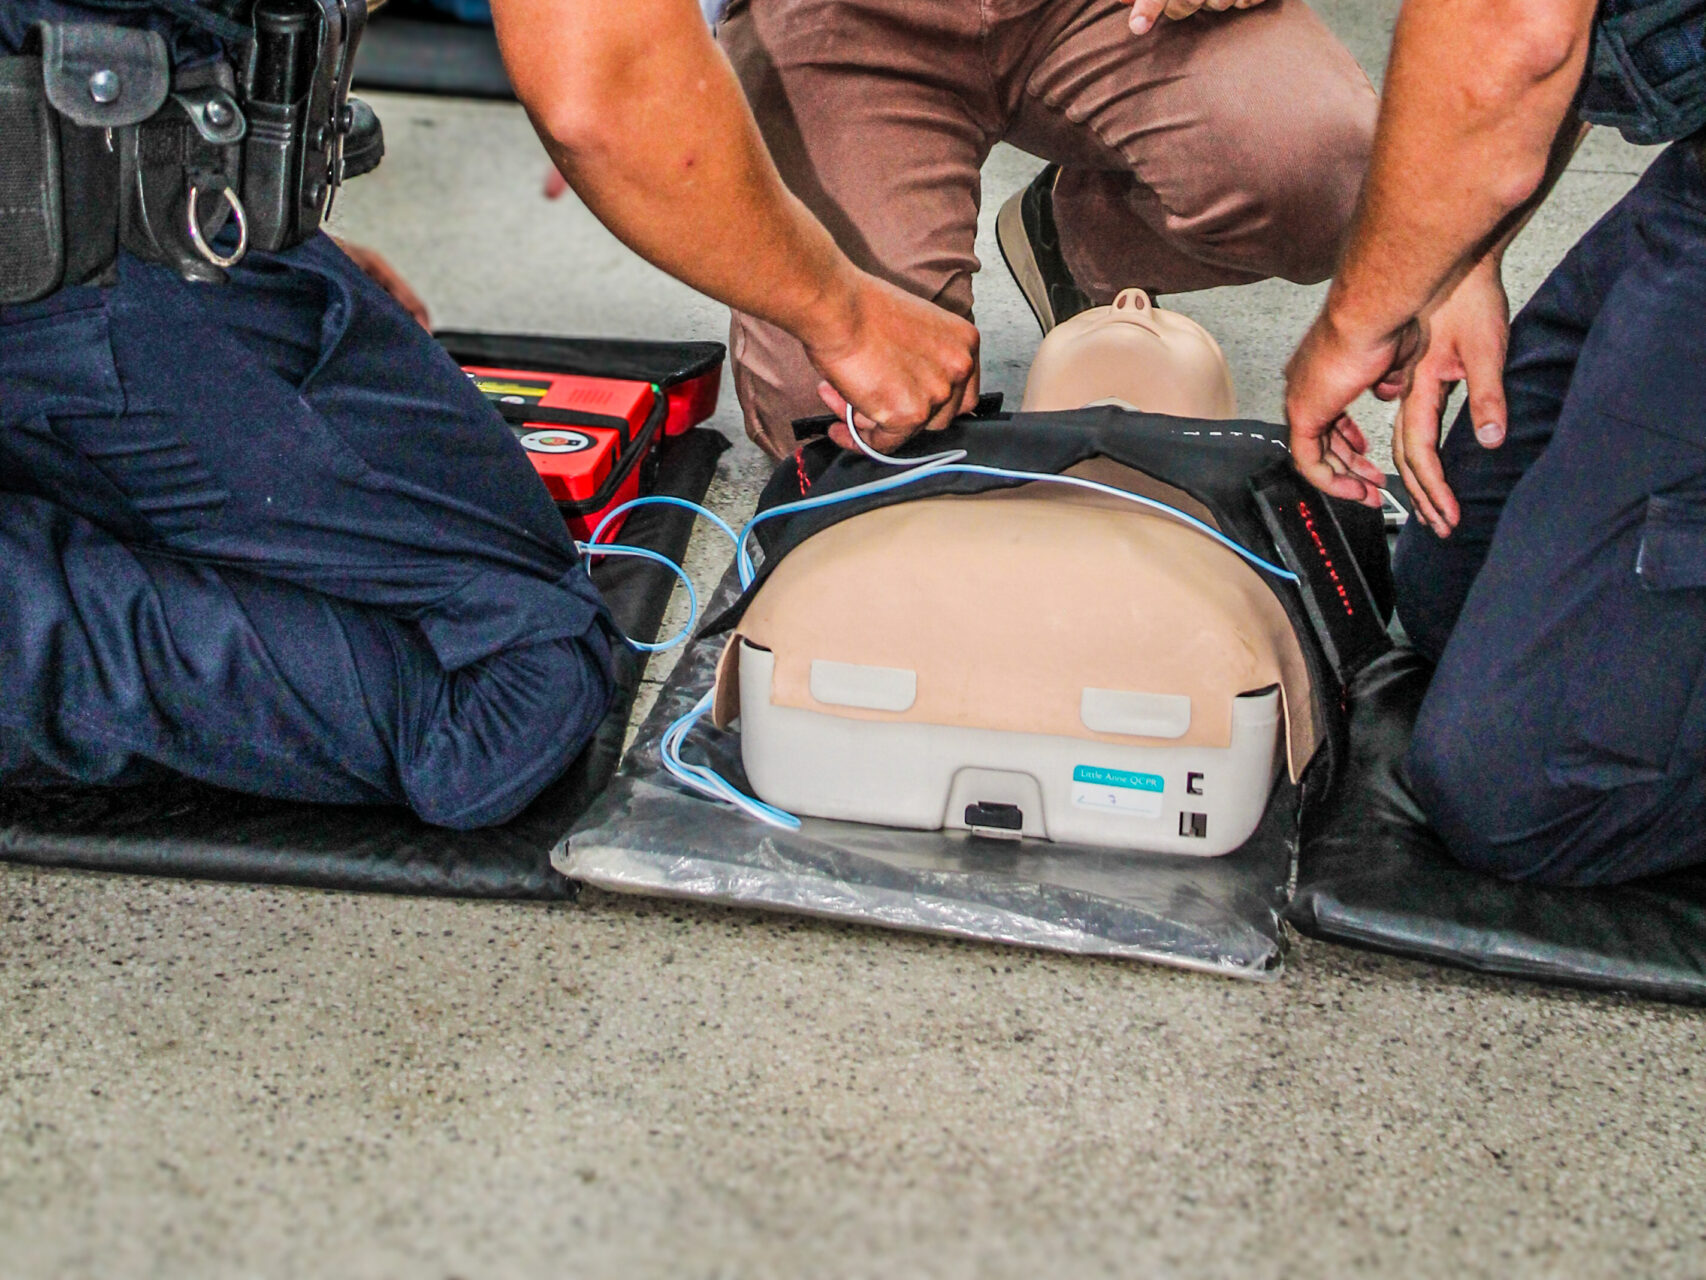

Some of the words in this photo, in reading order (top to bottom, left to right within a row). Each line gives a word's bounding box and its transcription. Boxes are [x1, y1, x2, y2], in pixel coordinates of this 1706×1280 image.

[1080, 768, 1102, 780] Little
[1105, 772, 1127, 783] Anne
[1130, 776, 1158, 787] QCPR
